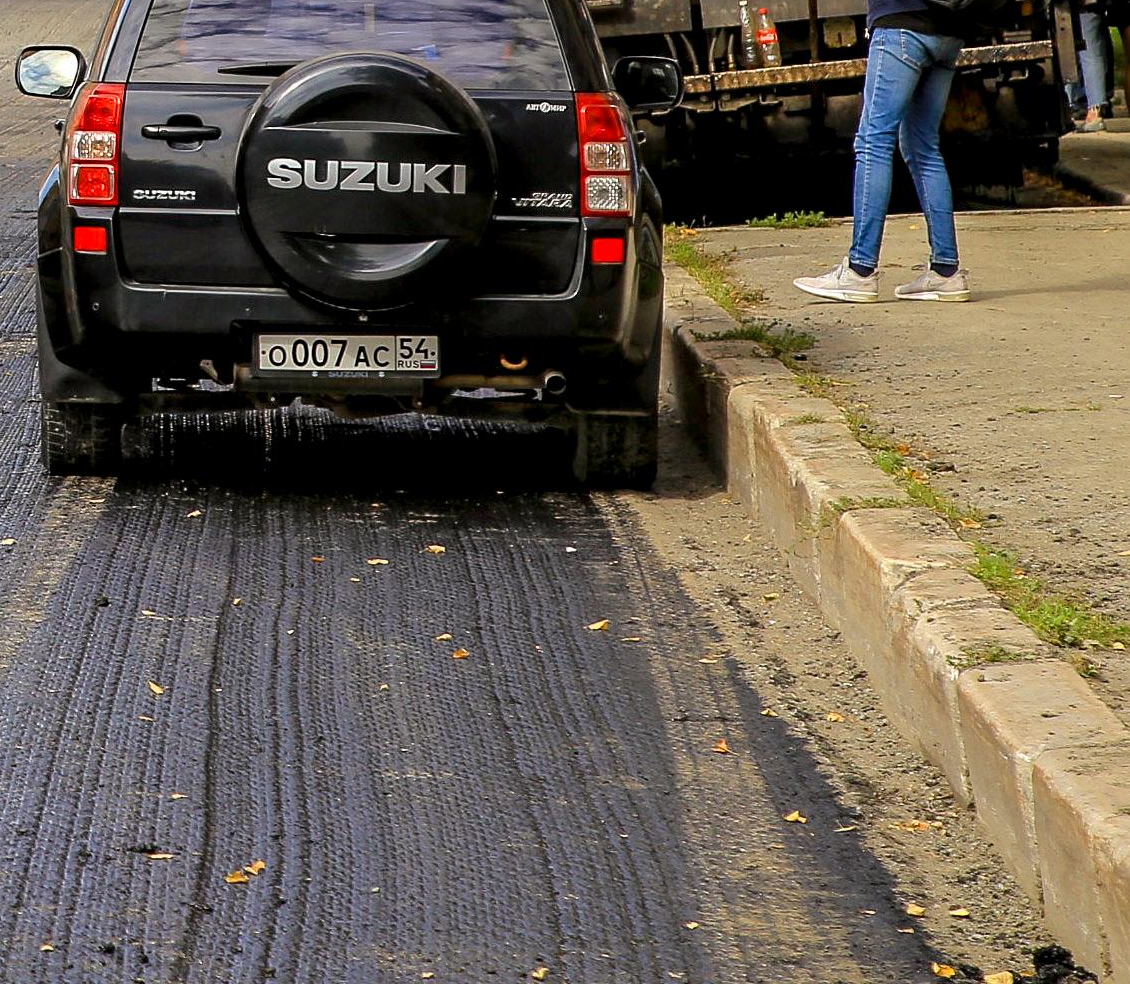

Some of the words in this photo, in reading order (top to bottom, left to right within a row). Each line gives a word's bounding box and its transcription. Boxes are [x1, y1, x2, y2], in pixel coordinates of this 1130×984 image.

[266, 157, 467, 194] SUZUKI
[133, 189, 197, 200] SUZUKI
[399, 338, 429, 359] 54
[397, 360, 420, 368] RUS
